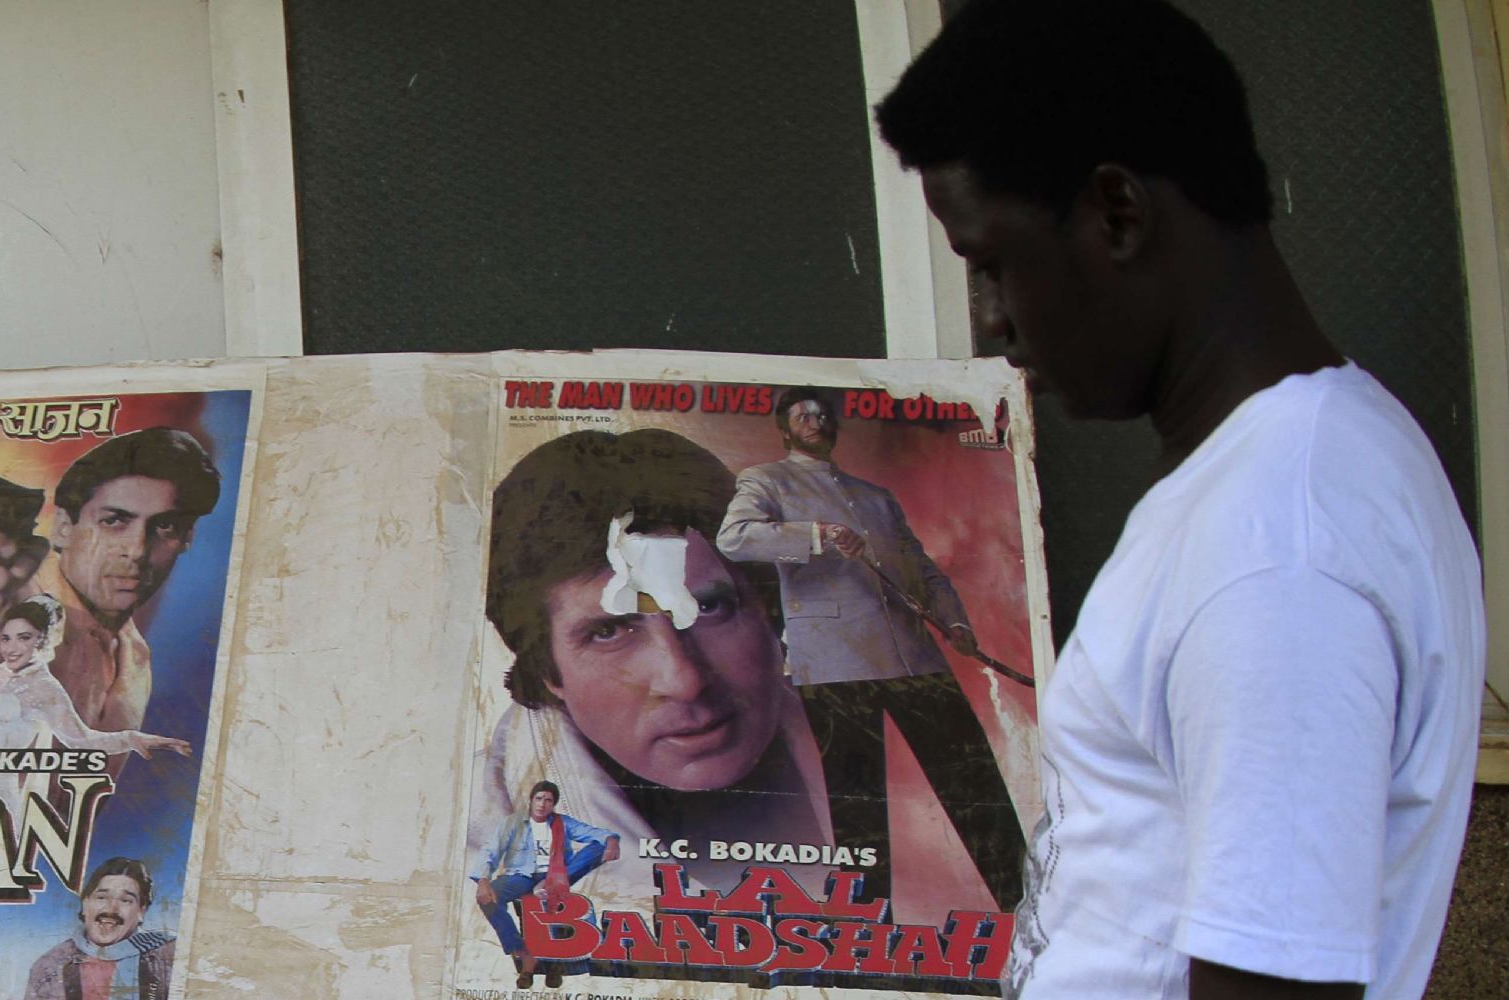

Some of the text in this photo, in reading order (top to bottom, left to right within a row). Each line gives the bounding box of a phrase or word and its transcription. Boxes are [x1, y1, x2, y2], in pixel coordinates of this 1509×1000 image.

[504, 380, 555, 409] THE
[557, 381, 624, 411] MAN
[629, 382, 695, 413] WHO
[700, 384, 774, 416] LIVES
[843, 389, 895, 420] FOR
[638, 837, 878, 867] K.C. BOKADIA'S
[654, 863, 890, 923] LAL
[520, 893, 1015, 983] BAADSHAH
